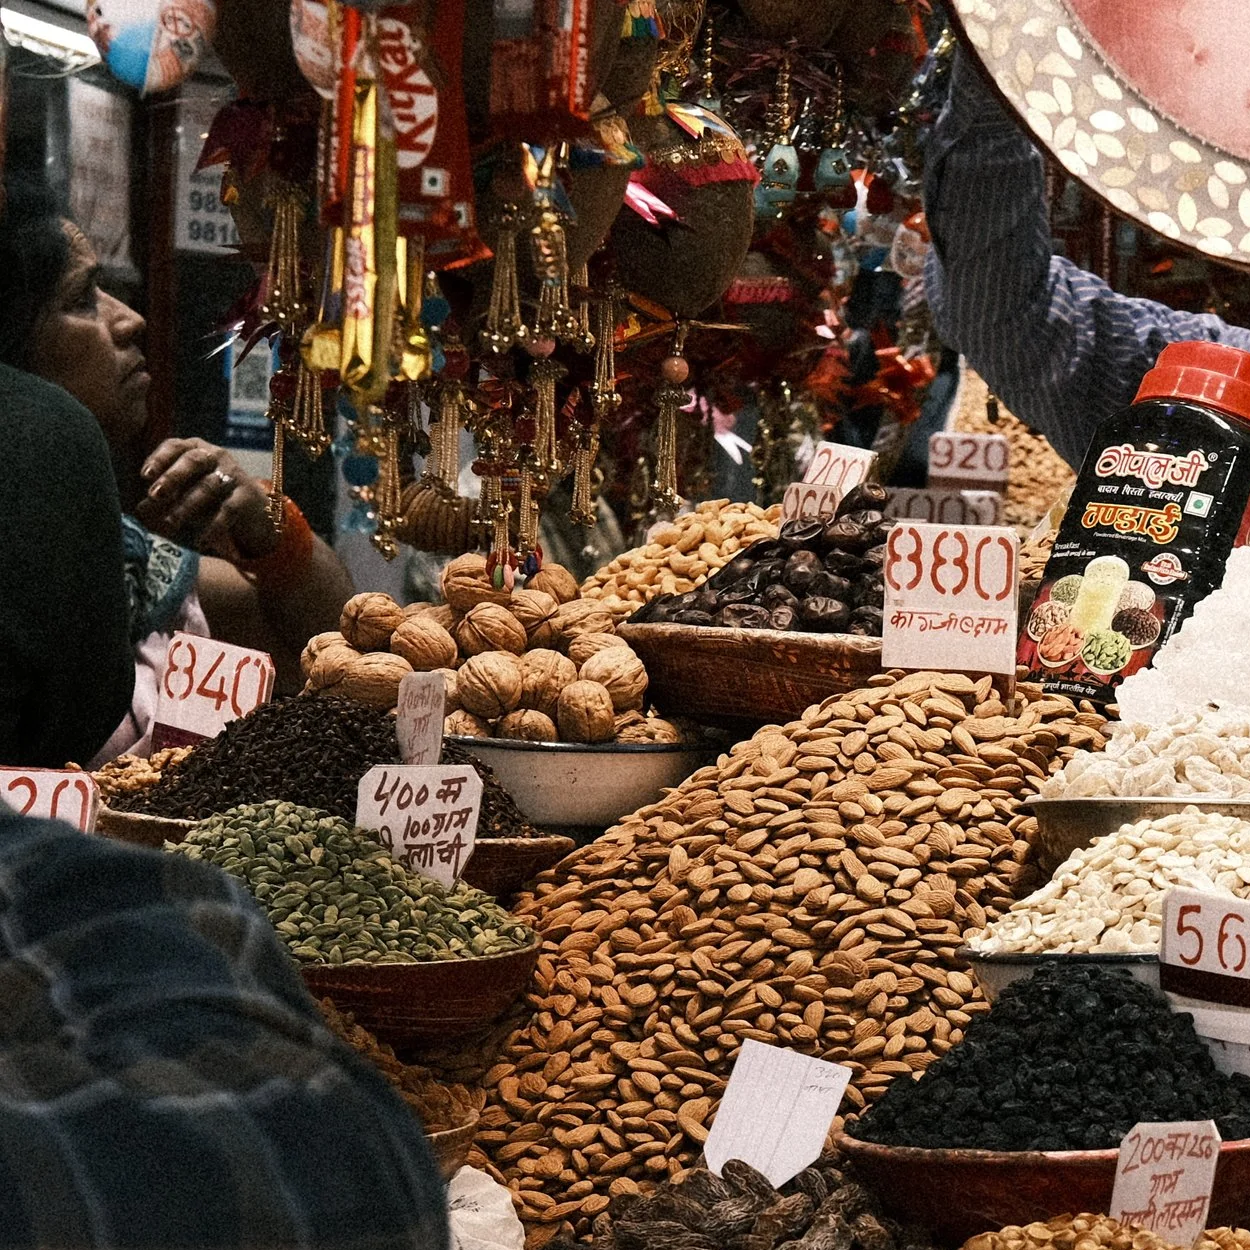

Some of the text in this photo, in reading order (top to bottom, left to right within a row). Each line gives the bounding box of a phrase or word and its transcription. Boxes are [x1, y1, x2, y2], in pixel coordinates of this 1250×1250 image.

[380, 29, 438, 153] KitKat
[189, 189, 228, 215] 98
[929, 438, 1008, 471] 920
[885, 527, 1014, 601] 880
[163, 640, 268, 717] 840
[374, 771, 429, 817] 400
